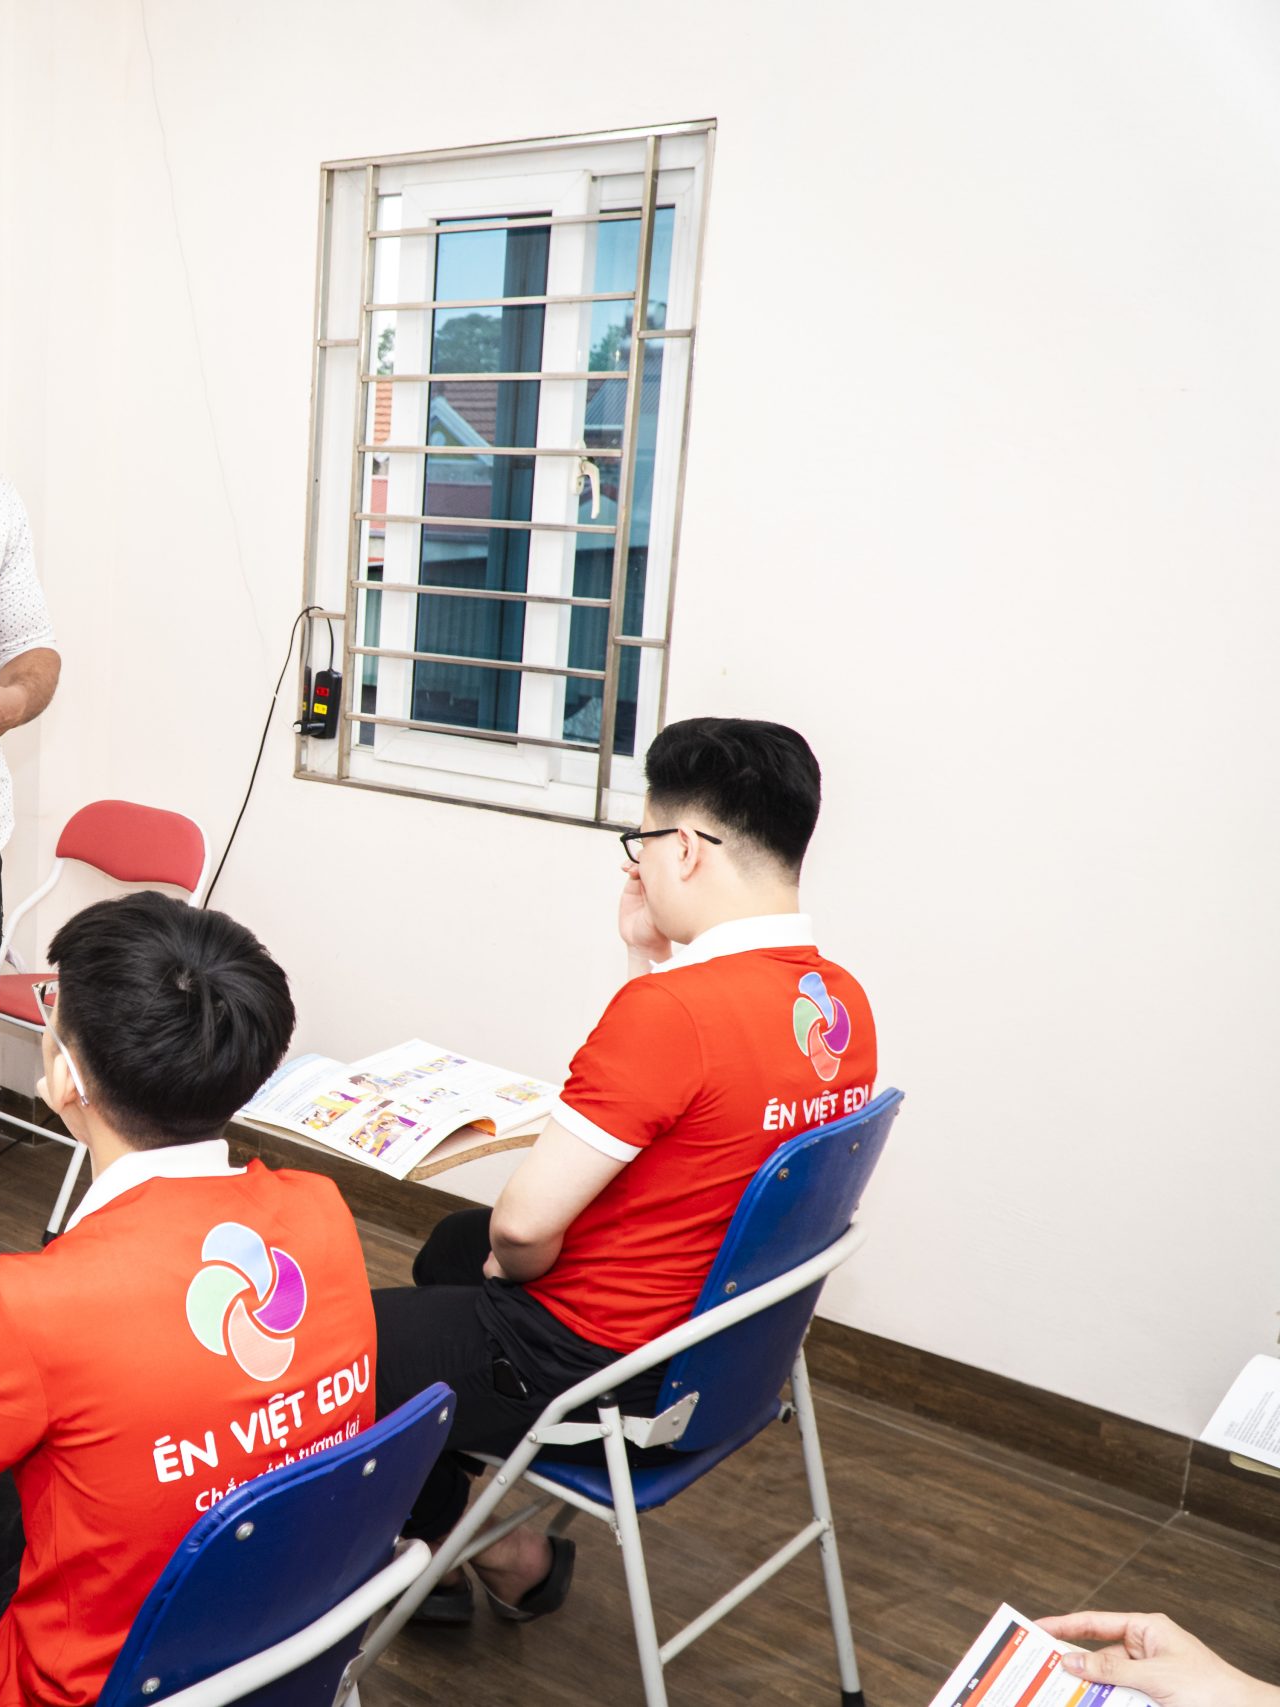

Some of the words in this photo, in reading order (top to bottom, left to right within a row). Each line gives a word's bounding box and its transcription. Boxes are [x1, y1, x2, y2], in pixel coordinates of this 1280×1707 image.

[763, 1097, 797, 1131] ÉN
[153, 1430, 218, 1483] ÉN
[230, 1390, 306, 1454] VIỆT
[316, 1354, 370, 1415] EDU
